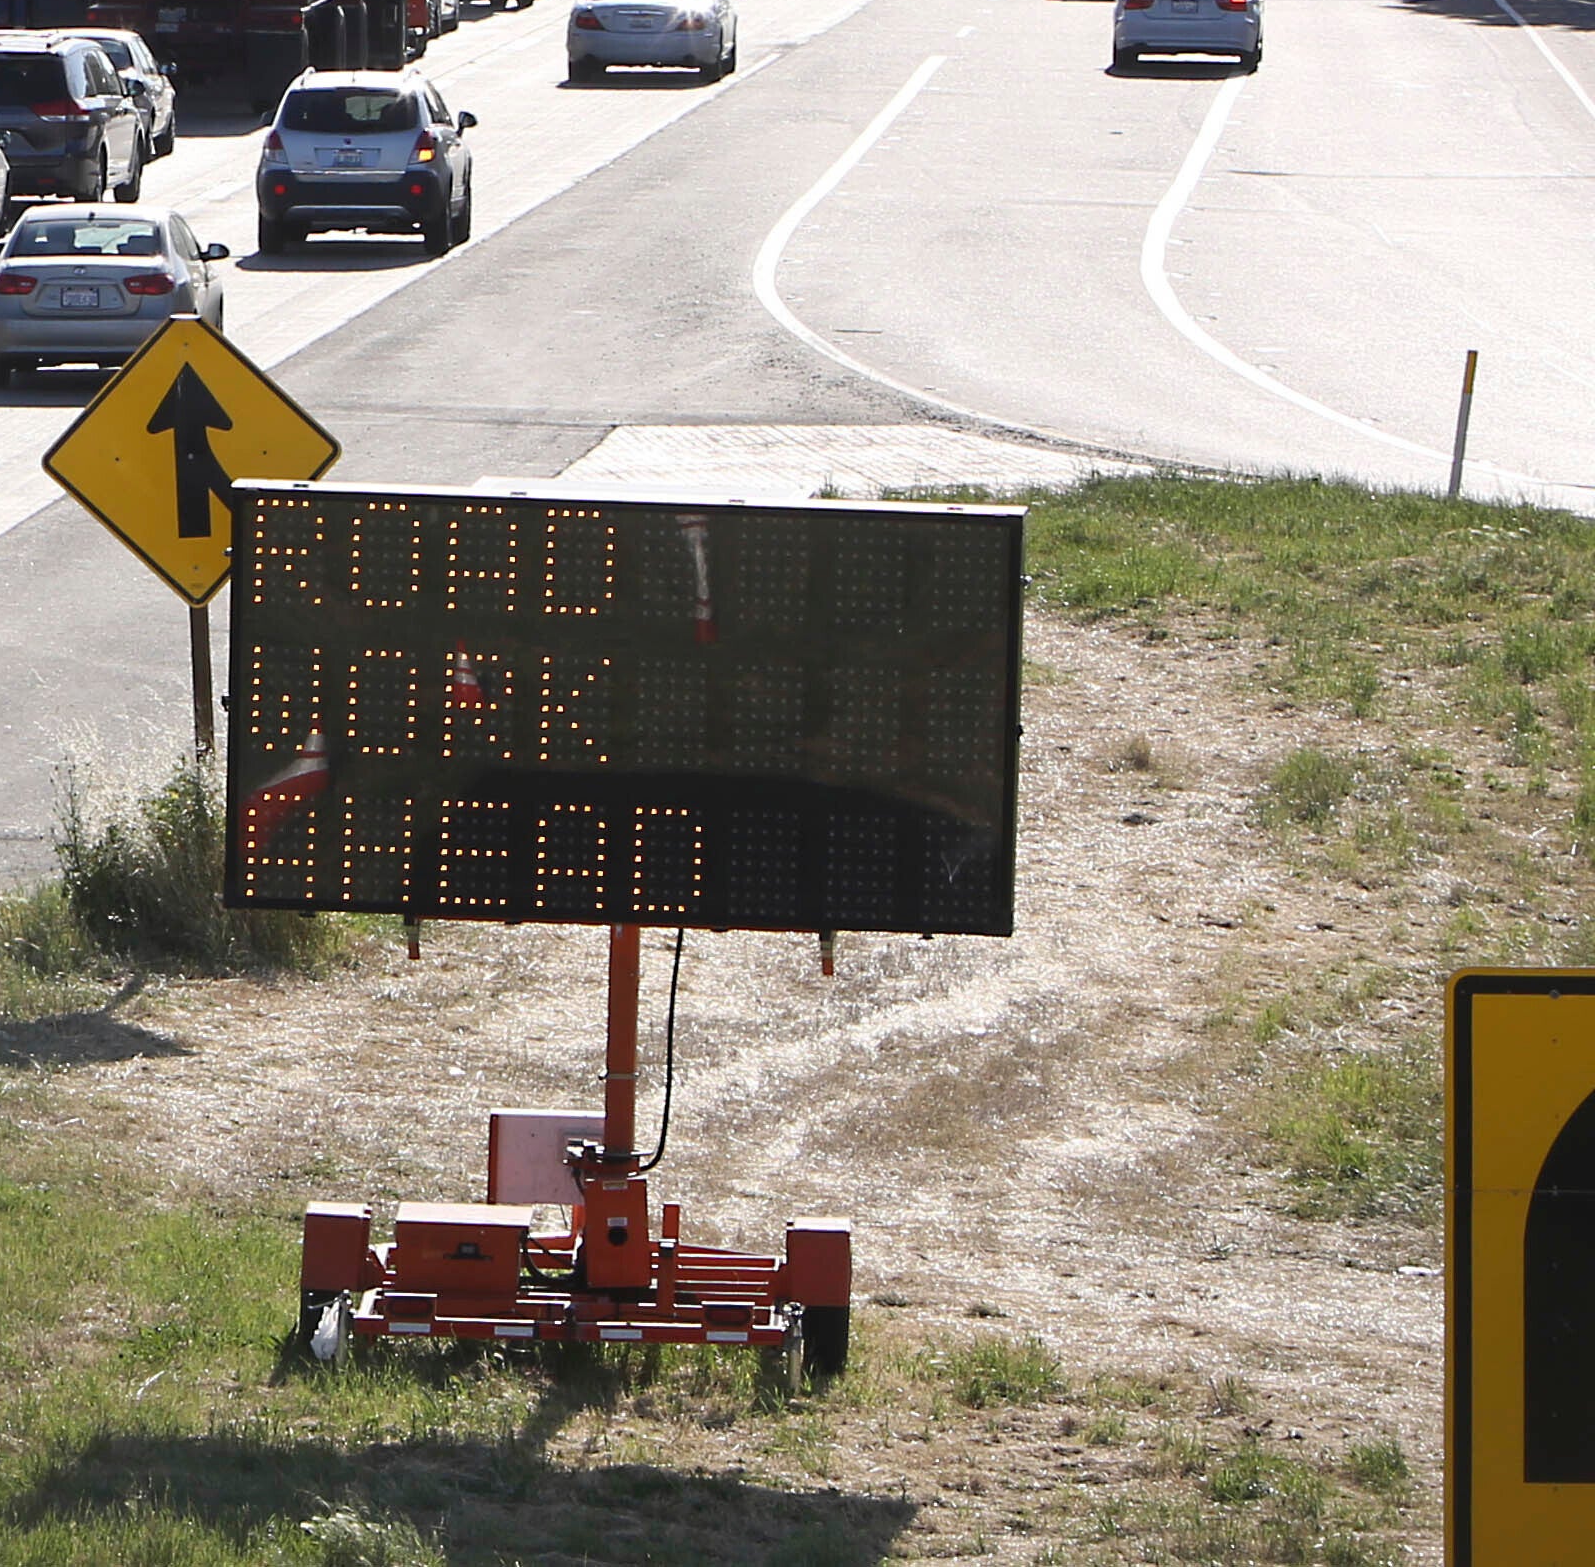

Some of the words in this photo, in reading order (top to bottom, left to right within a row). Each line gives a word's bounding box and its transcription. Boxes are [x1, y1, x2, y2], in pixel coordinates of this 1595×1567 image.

[252, 497, 616, 617] ROAD
[248, 644, 613, 764] WORK
[244, 792, 706, 915] AHEAD
